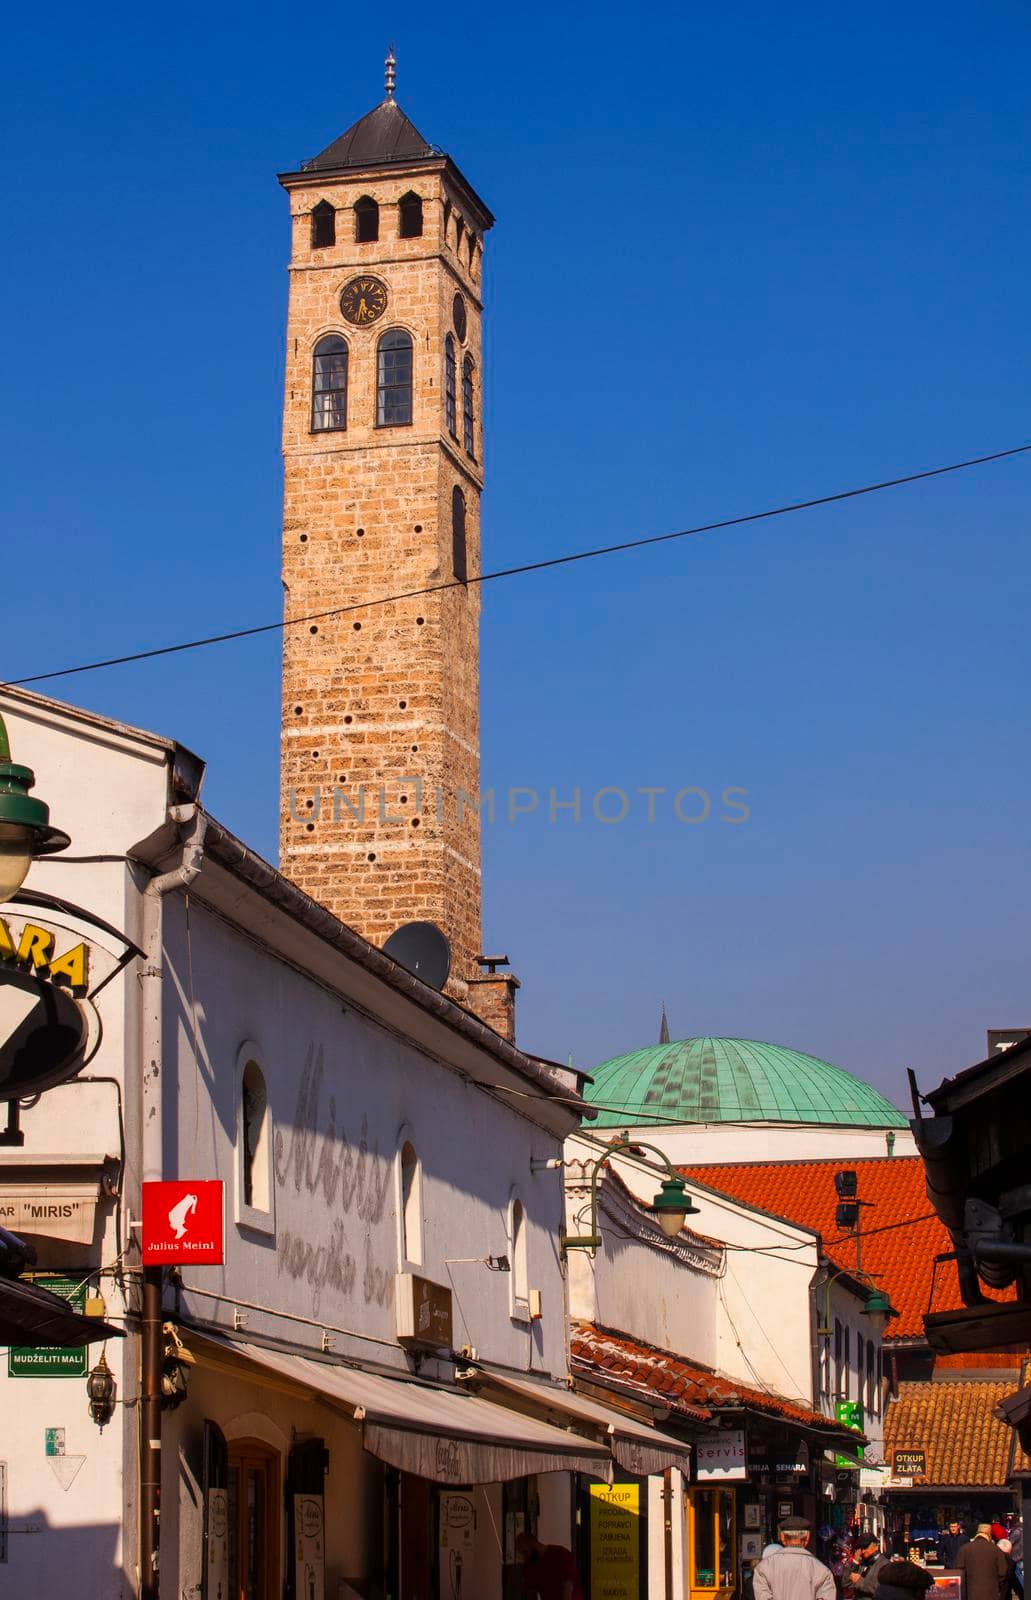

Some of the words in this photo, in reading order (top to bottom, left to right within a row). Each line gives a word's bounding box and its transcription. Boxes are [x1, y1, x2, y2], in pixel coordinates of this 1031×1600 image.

[147, 1242, 179, 1251] Julius
[182, 1241, 214, 1250] Meinl
[13, 1354, 60, 1363] MUDŽELITI
[61, 1355, 83, 1363] MALI
[698, 1446, 745, 1459] Servis
[896, 1454, 924, 1462] OTKUP
[599, 1492, 631, 1502] OTKUP
